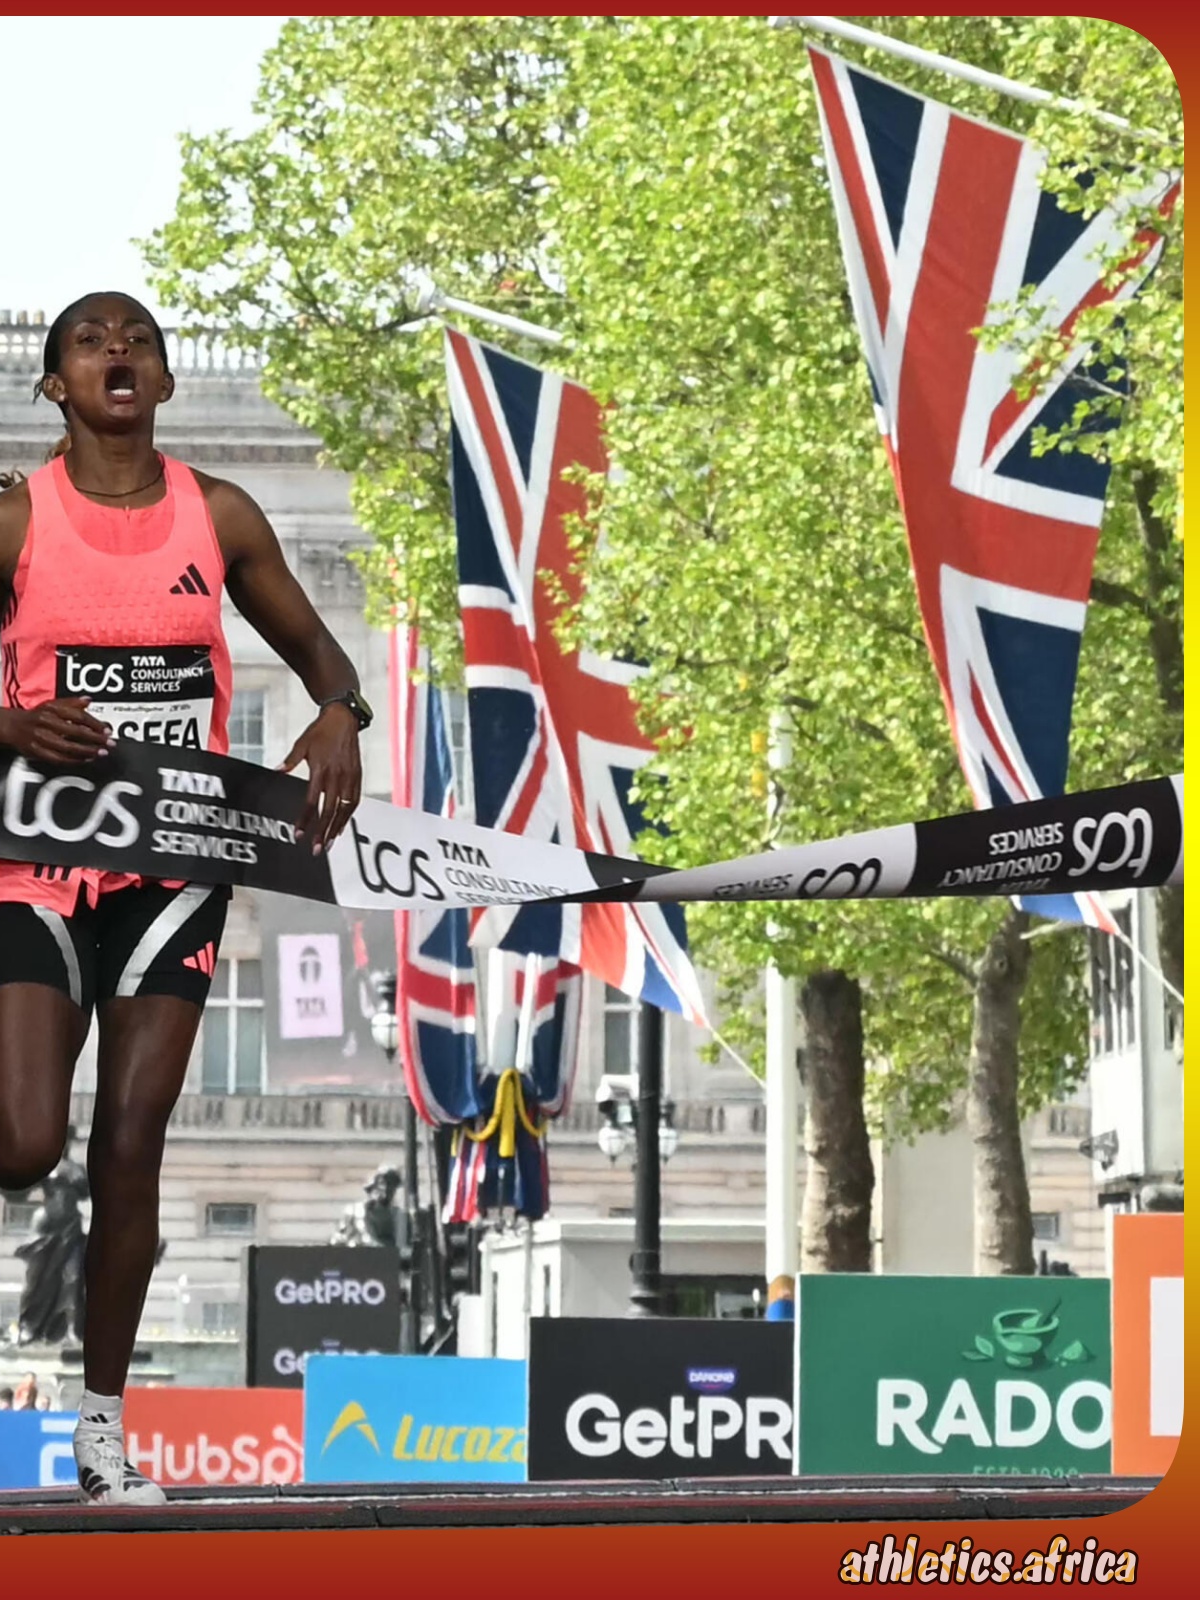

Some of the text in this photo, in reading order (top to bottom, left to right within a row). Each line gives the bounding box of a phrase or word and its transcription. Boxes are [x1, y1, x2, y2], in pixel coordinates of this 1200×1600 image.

[66, 656, 124, 692] tcs
[131, 656, 166, 667] TATA
[131, 666, 204, 681] CONSULTANCY
[131, 680, 181, 693] SERVICES
[157, 767, 226, 799] TATA
[3, 757, 143, 848] tcs
[155, 799, 297, 844] CONSULTANCY
[989, 822, 1064, 855] SERVICES
[150, 829, 258, 864] SERVICES
[351, 816, 445, 900] tcs
[437, 838, 491, 868] TATA
[1068, 808, 1153, 878] tcs
[275, 1279, 386, 1305] GetPRO
[566, 1393, 793, 1459] GetPR
[876, 1379, 1112, 1454] RADO
